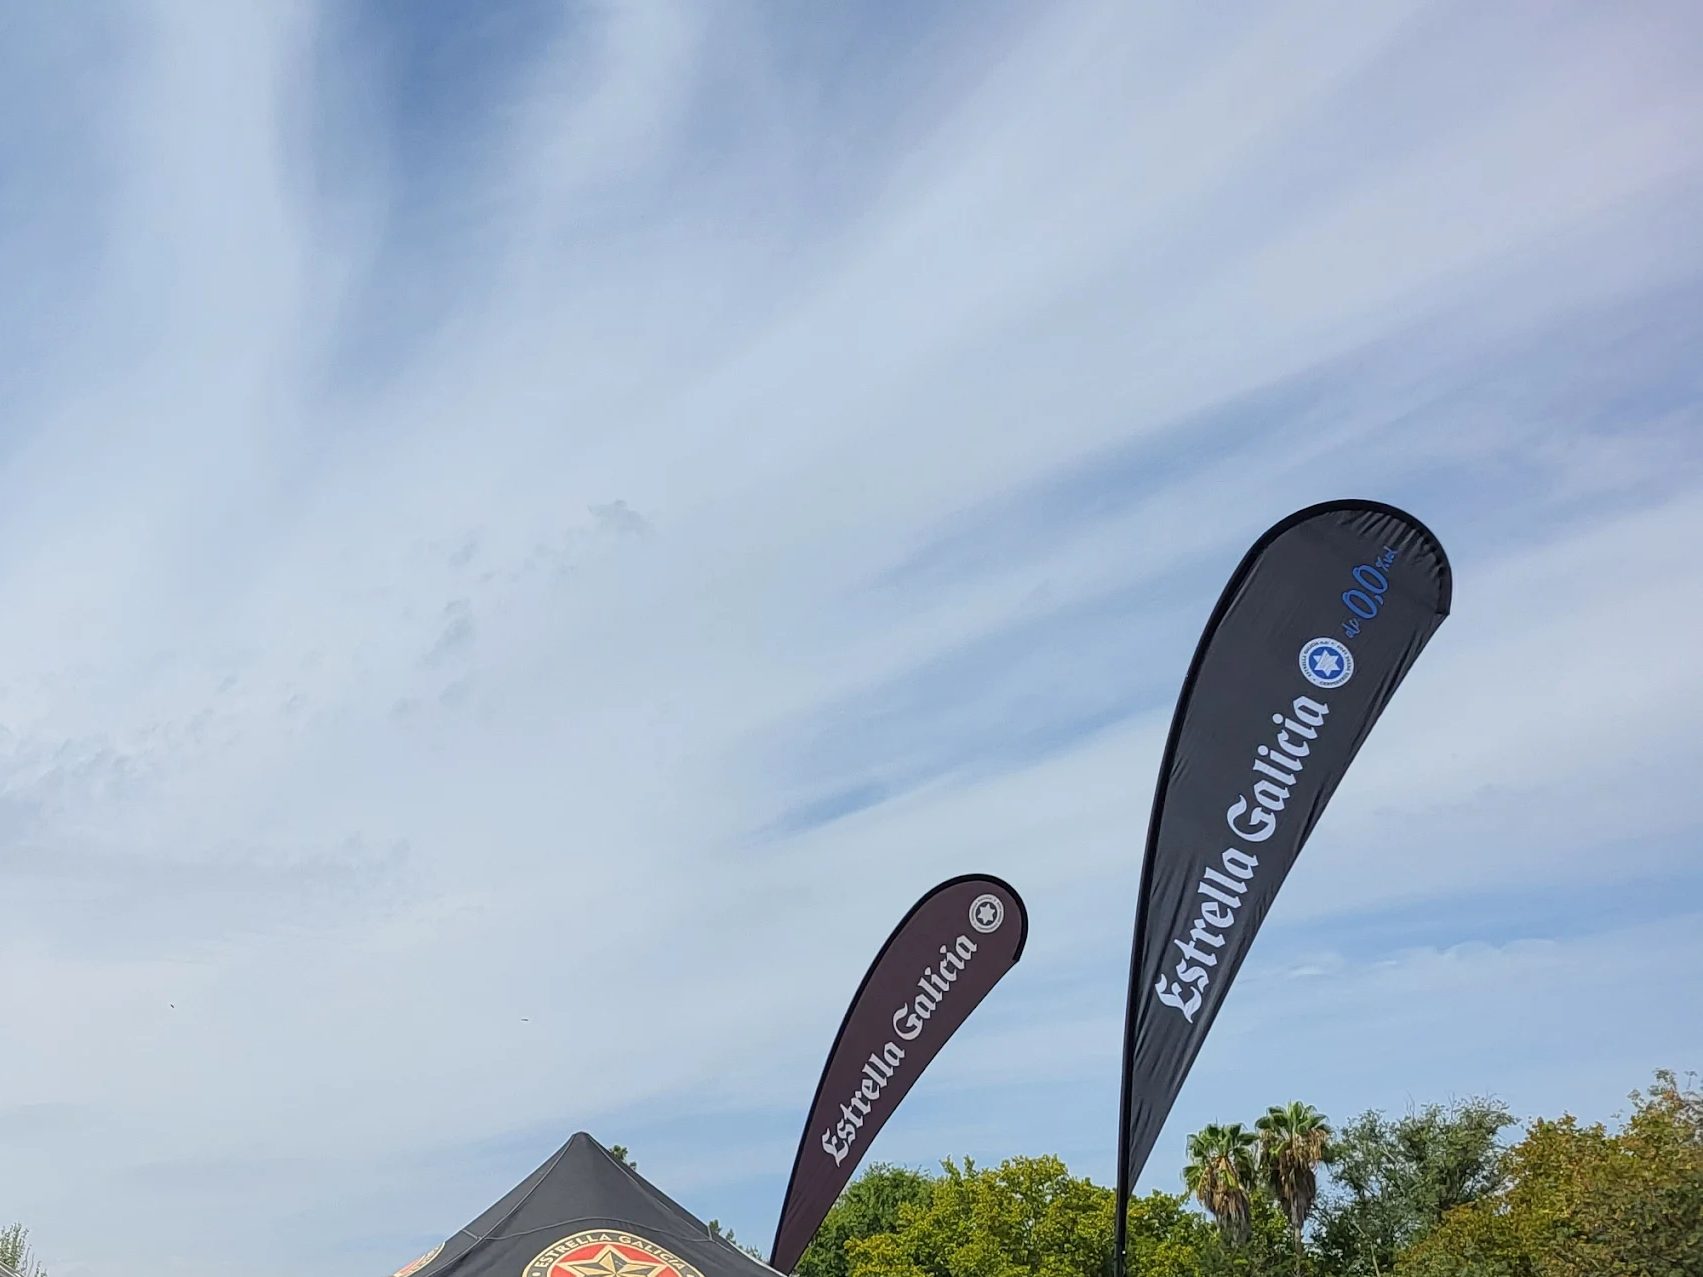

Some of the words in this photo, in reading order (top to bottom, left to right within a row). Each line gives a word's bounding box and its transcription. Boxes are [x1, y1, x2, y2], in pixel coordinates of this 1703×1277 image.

[1342, 565, 1388, 619] 0,0
[1154, 846, 1259, 1024] Estrella
[1226, 695, 1330, 843] Galicia
[822, 1041, 905, 1168] Estrella
[893, 934, 978, 1041] Galicia
[534, 1233, 612, 1268] ESTRELLA
[618, 1235, 686, 1269] GALICIA
